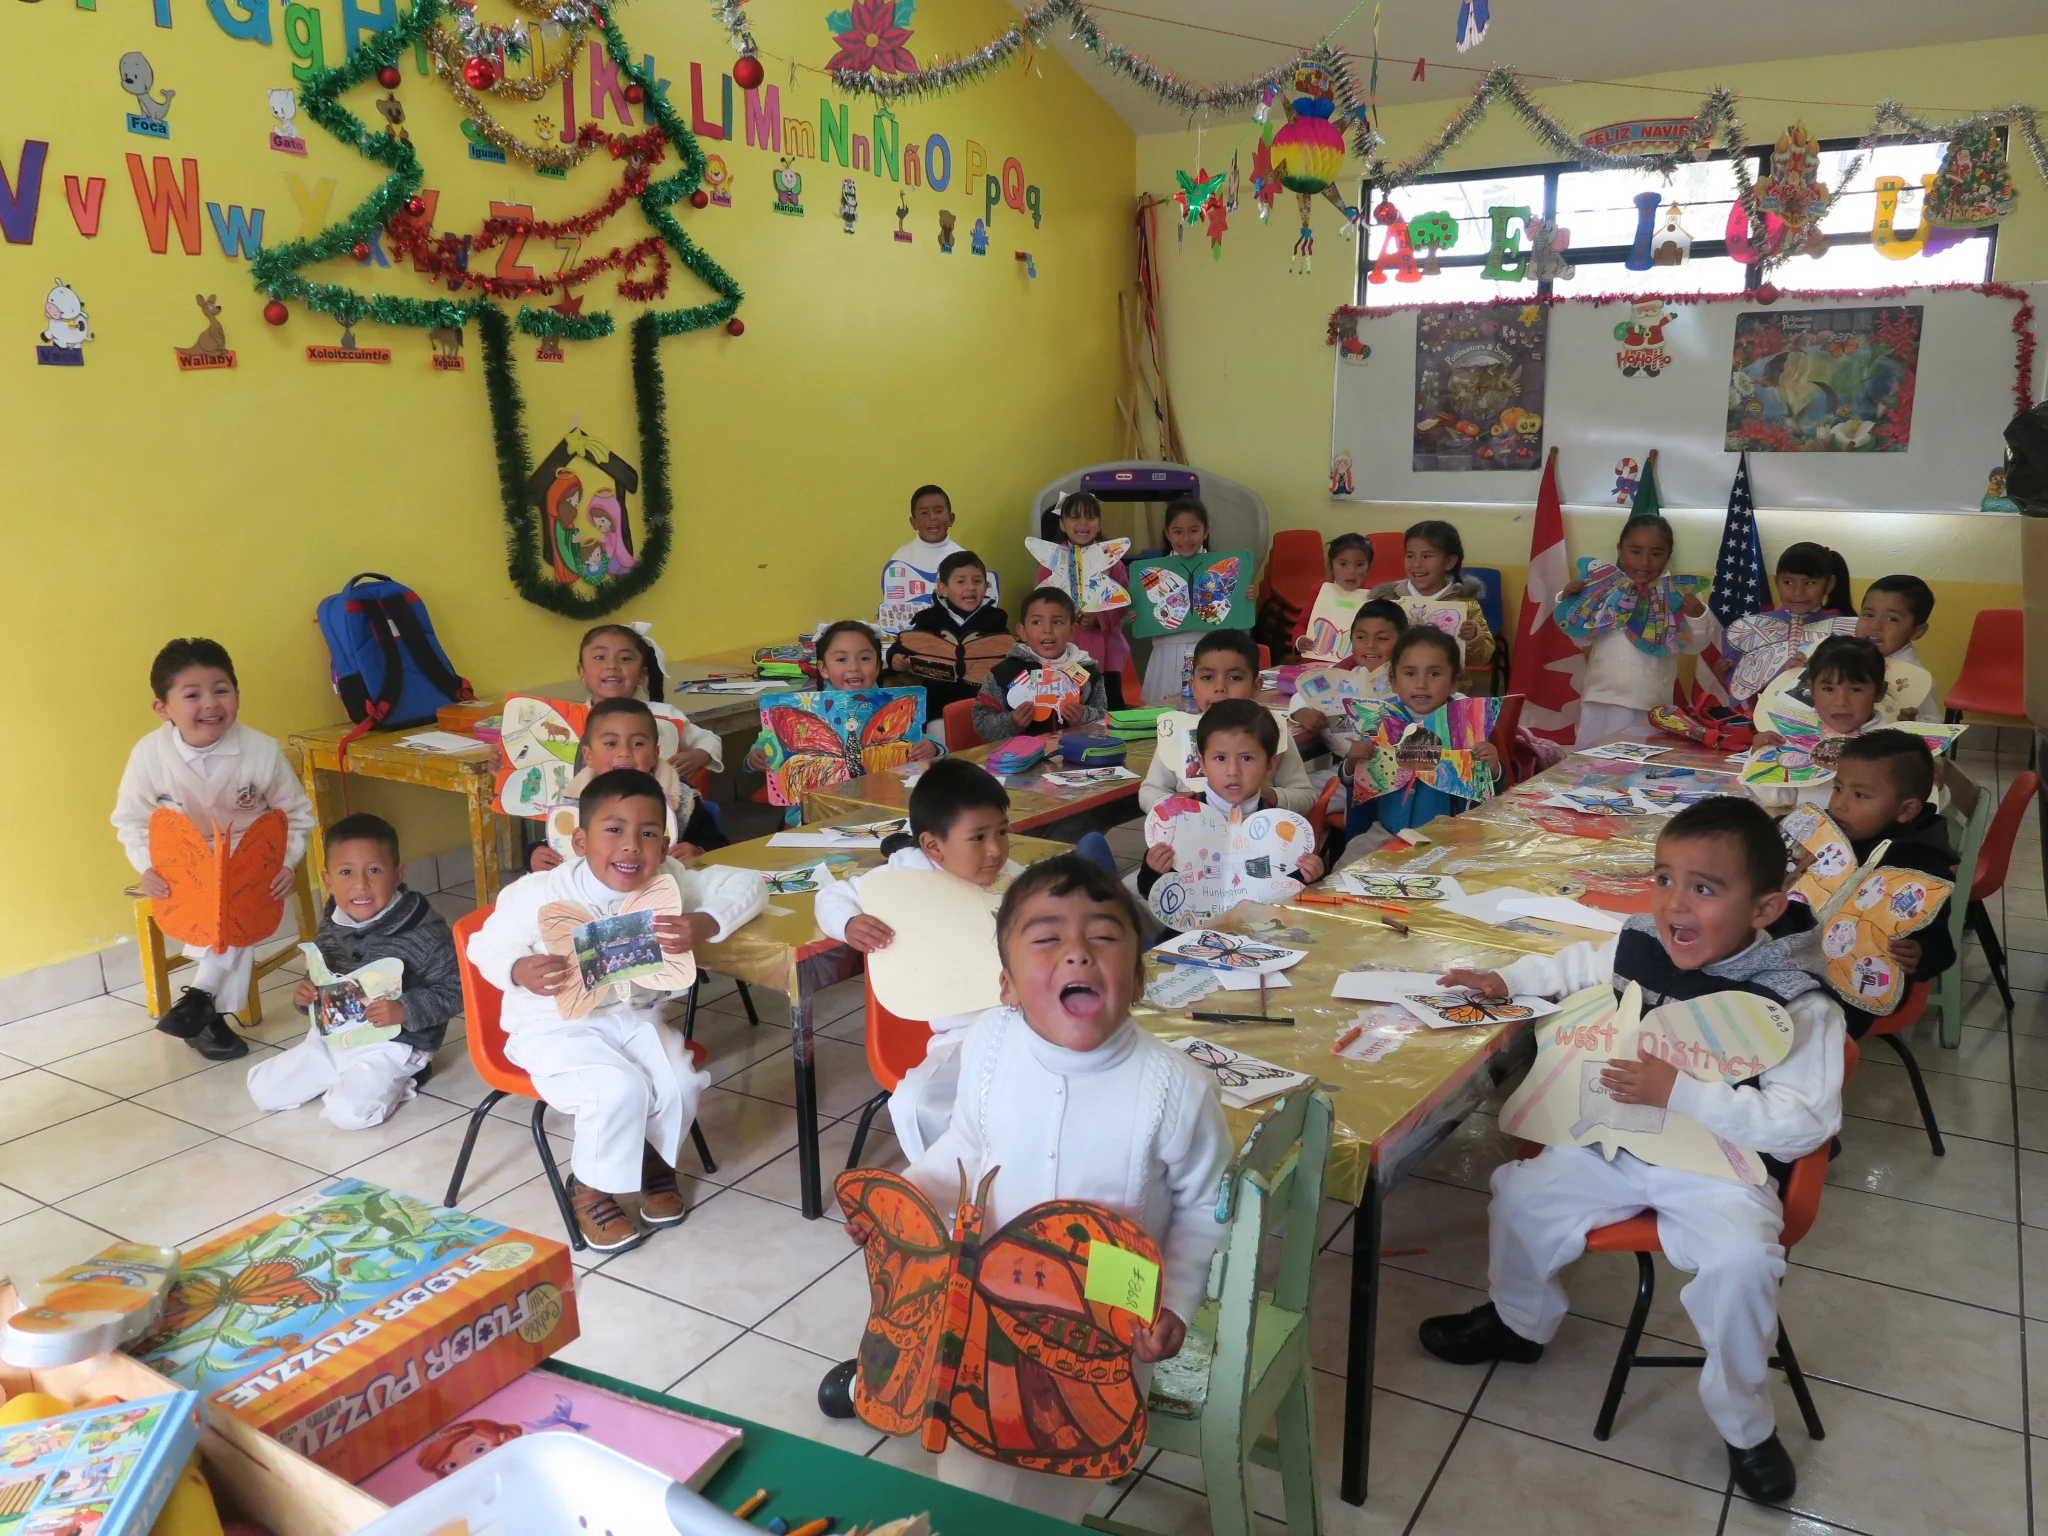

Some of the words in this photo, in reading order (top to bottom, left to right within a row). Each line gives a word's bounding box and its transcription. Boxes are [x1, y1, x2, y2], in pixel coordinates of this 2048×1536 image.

[130, 117, 167, 134] Foca
[273, 135, 303, 151] Gato
[1585, 126, 1631, 148] FELIZ
[471, 147, 505, 162] Iguana
[774, 203, 804, 215] Mariposa
[179, 353, 234, 369] Wallaby
[308, 347, 390, 361] Xoloitzcuintle
[537, 350, 563, 361] Zorro
[1444, 344, 1486, 365] Pollinators
[1495, 343, 1514, 363] Seeds
[433, 357, 461, 369] Yegua
[1202, 886, 1248, 903] Huntington
[1554, 1024, 1620, 1053] WEST
[1637, 1031, 1768, 1077] District
[368, 1253, 491, 1321] FLOOR
[422, 1290, 534, 1381] FLOOR
[213, 1318, 382, 1410] PUZZLE
[298, 1358, 422, 1457] PUZZL
